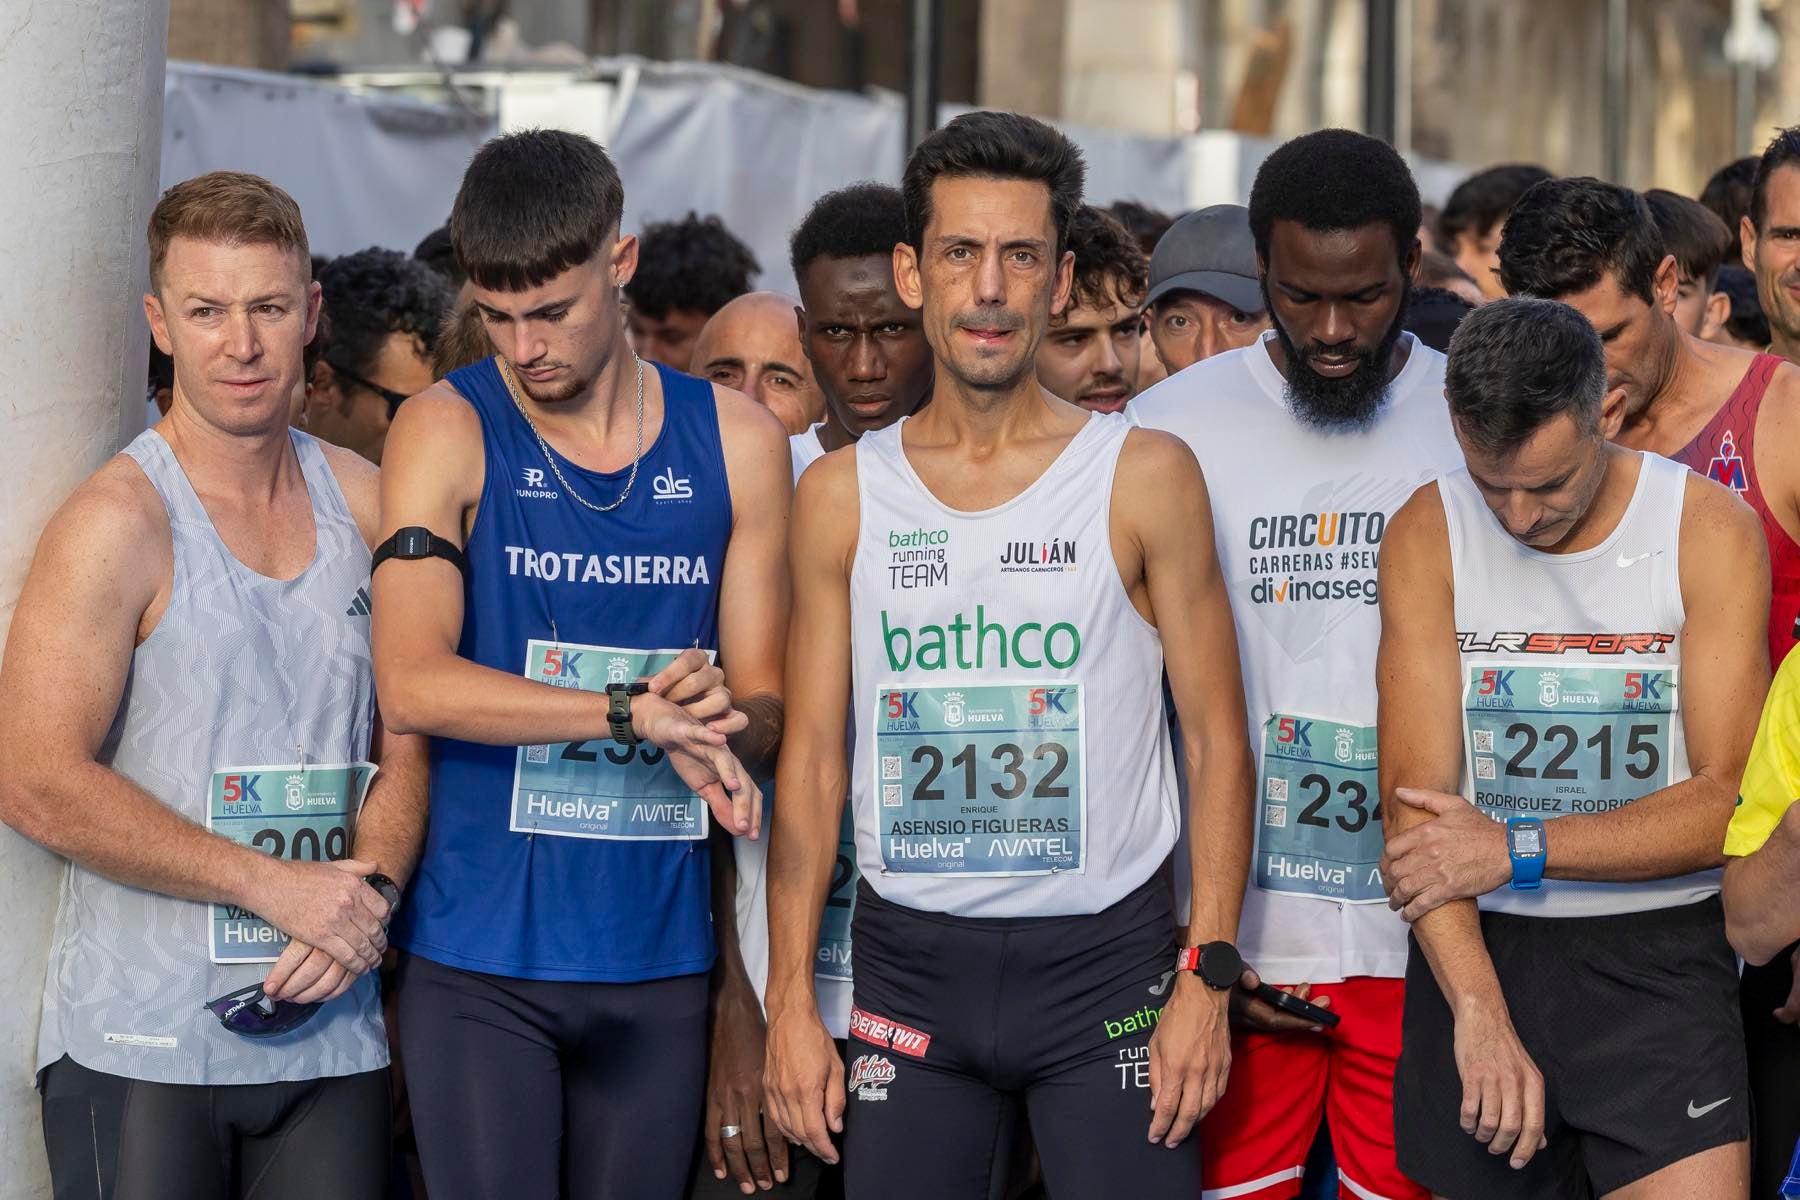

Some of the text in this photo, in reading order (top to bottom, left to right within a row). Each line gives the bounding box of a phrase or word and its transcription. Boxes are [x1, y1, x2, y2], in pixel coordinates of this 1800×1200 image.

[889, 528, 949, 547] bathco
[1249, 512, 1385, 550] CIRCUITO
[892, 547, 945, 563] running
[1000, 537, 1076, 564] JULIÁN
[505, 546, 710, 585] TROTASIERRA
[888, 562, 948, 590] TEAM
[1249, 552, 1333, 575] CARRERAS
[1250, 575, 1378, 606] divinaseg
[881, 604, 1081, 672] bathco
[542, 649, 581, 679] 5K
[1478, 669, 1662, 700] 5K 5K
[888, 688, 1067, 719] 5K 5K
[1476, 695, 1662, 711] HUELVA HUELVA HUELVA
[887, 720, 920, 731] HUELVA
[968, 714, 1004, 723] HUELVA
[1277, 717, 1313, 747] 5K
[1276, 745, 1312, 759] HUELVA
[1505, 722, 1660, 780] 2215
[911, 743, 1069, 801] 2132
[223, 774, 262, 802] 5K
[1555, 786, 1586, 794] ISRAEL
[223, 797, 337, 815] HUELVA HUELVA
[527, 794, 695, 822] Huelva AVATEL
[960, 806, 998, 814] ENRIQUE
[1477, 791, 1562, 812] RODRIGUEZ
[579, 822, 608, 831] original
[890, 817, 1069, 836] ASENSIO FIGUERAS
[890, 837, 1073, 859] Huelva AVATEL
[937, 860, 965, 869] original
[1267, 855, 1346, 885] Huelva
[1318, 885, 1345, 894] original
